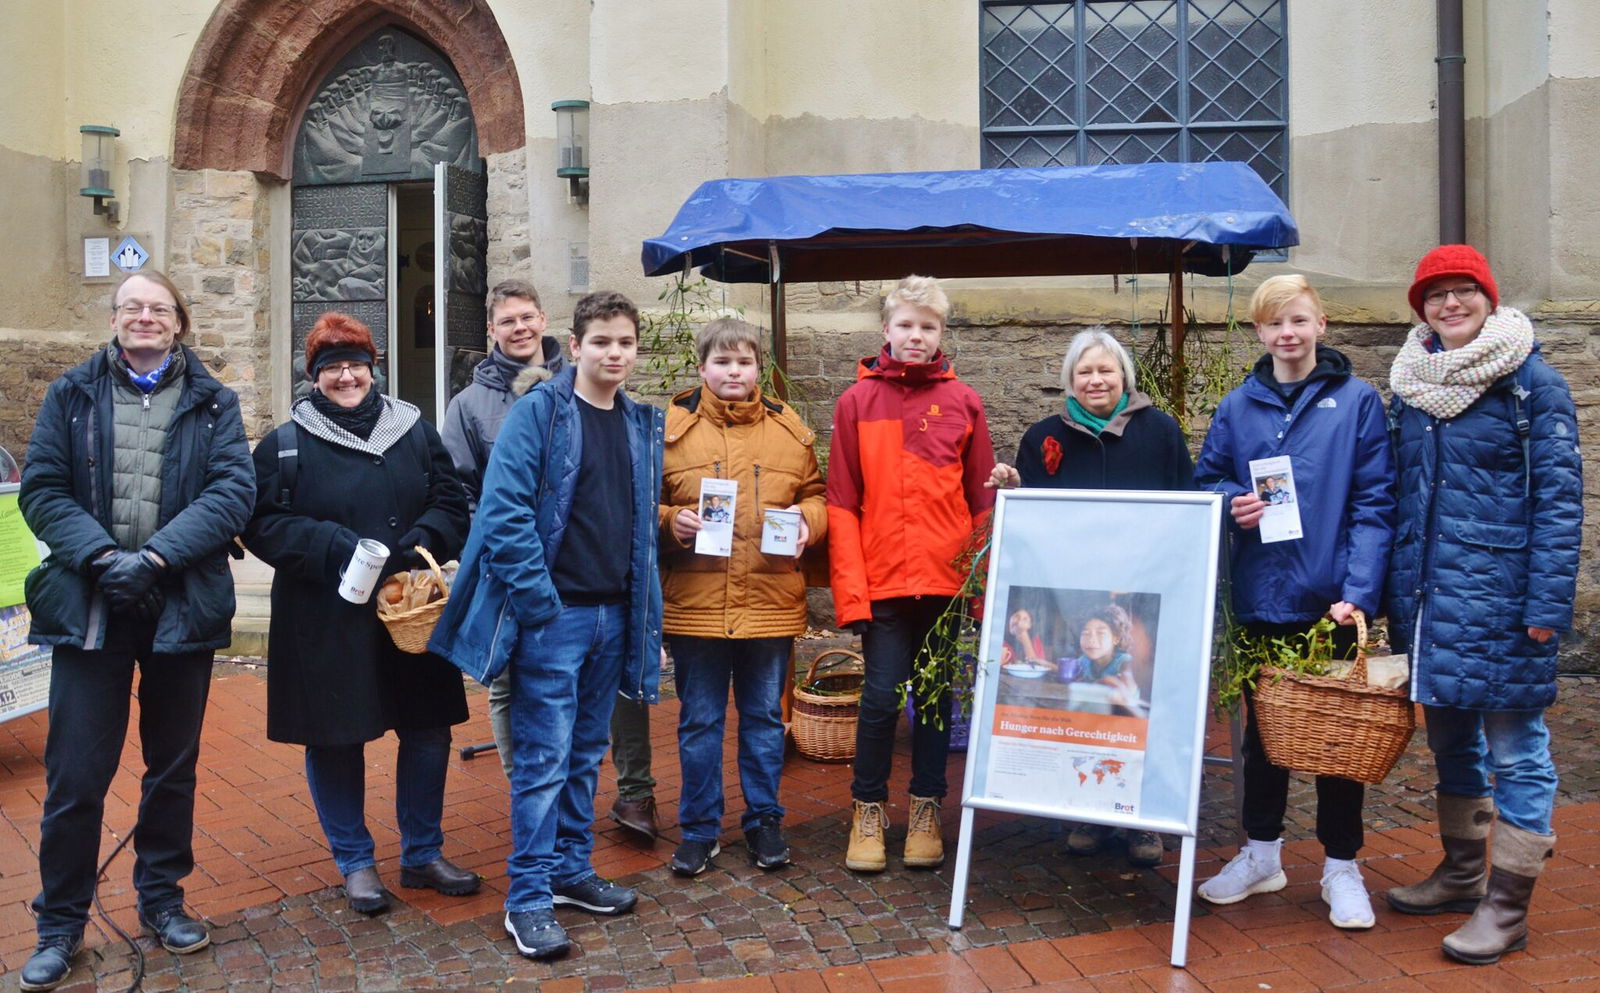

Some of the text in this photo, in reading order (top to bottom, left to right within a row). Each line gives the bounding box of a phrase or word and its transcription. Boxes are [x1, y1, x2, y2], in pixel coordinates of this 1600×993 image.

[1000, 720, 1137, 743] Hunger nach Gerechtigkeit
[1115, 802, 1134, 811] Brot
